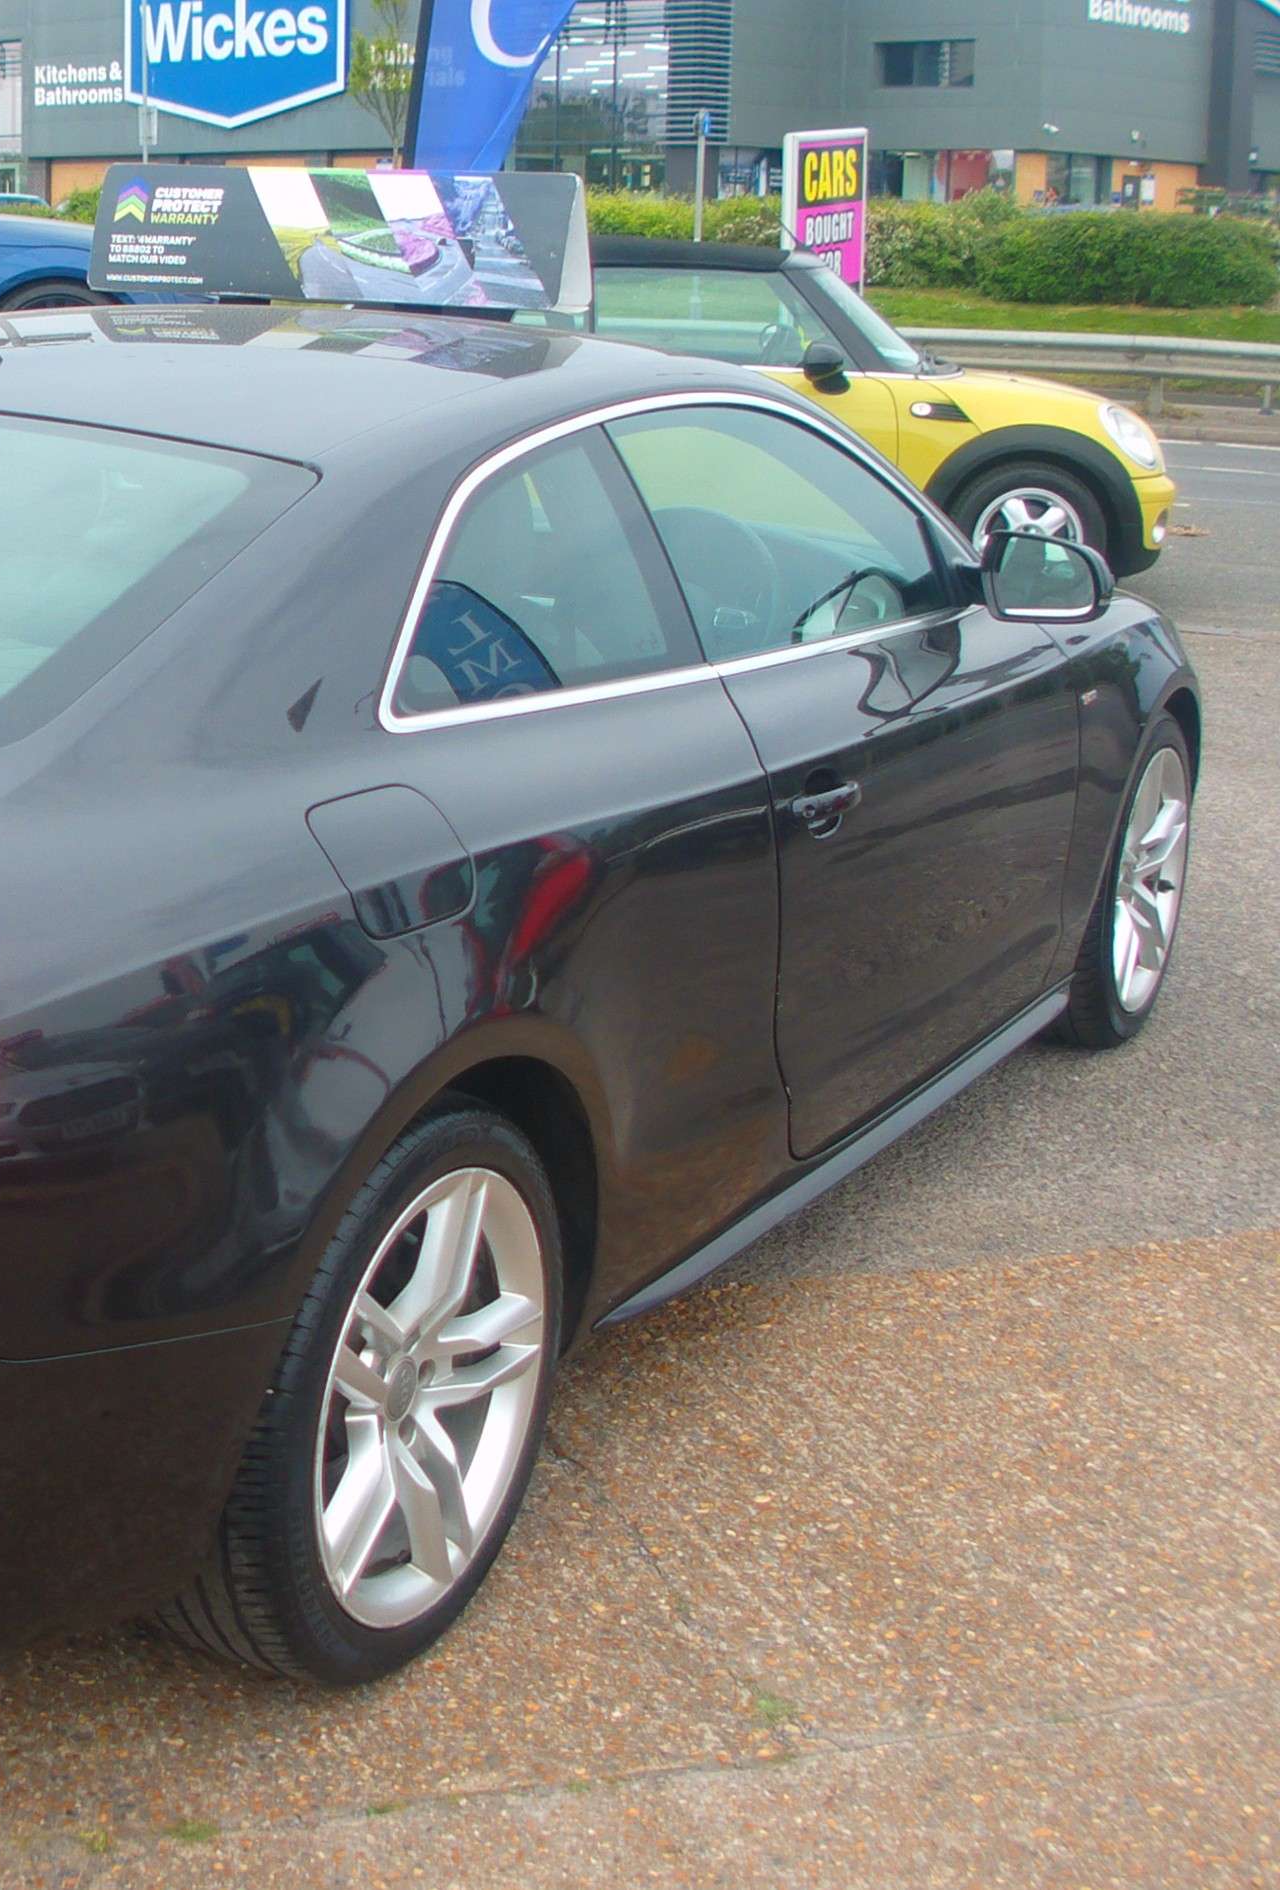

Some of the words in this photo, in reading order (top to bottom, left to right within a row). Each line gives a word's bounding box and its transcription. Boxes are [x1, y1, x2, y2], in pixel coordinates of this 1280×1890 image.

[1088, 0, 1190, 33] Bathrooms
[140, 0, 329, 63] Wickes
[34, 64, 107, 84] Kitchens
[109, 60, 122, 80] &
[34, 85, 123, 105] Bathrooms
[804, 148, 858, 202] CARS
[155, 187, 224, 200] CUSTOMER
[152, 199, 222, 213] PROTECT
[151, 212, 219, 225] WARRANTY
[805, 212, 854, 246] BOUGHT
[110, 245, 121, 253] TO
[152, 246, 164, 255] TO
[139, 255, 158, 265] OUR
[159, 256, 187, 265] VIDEO
